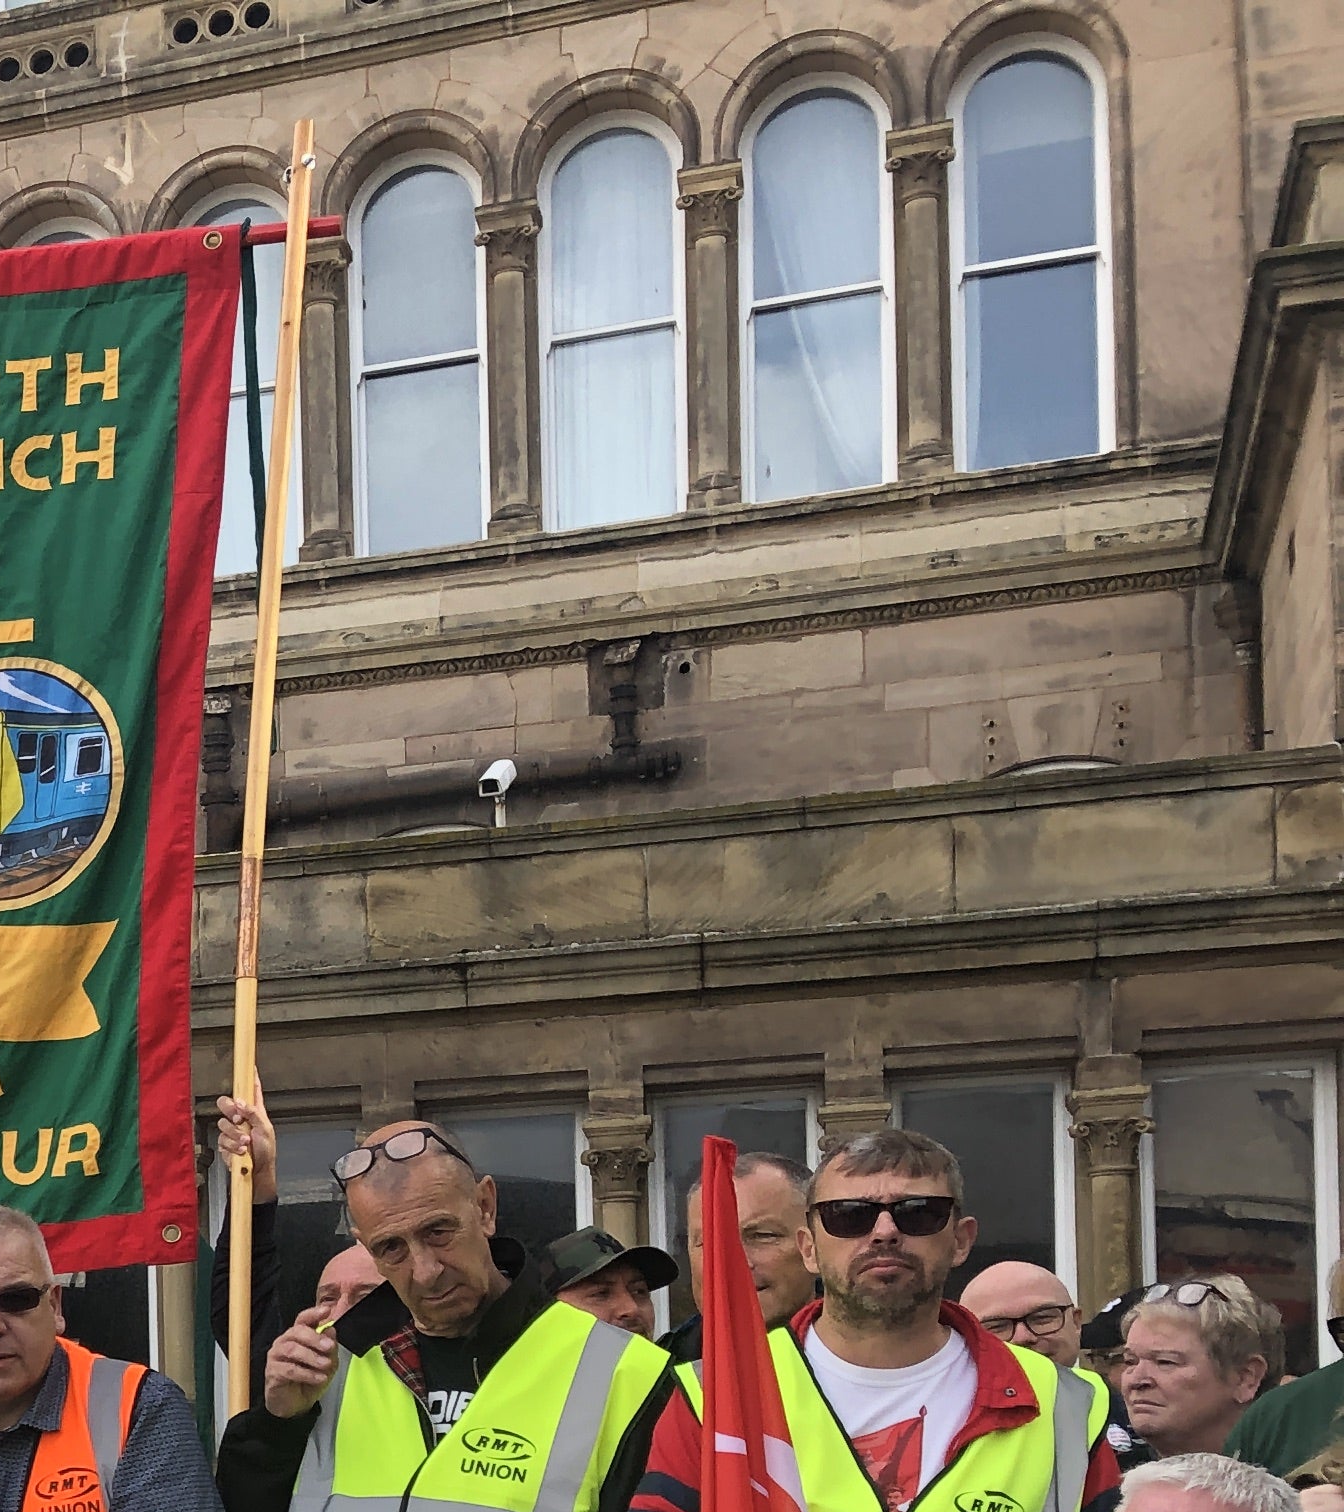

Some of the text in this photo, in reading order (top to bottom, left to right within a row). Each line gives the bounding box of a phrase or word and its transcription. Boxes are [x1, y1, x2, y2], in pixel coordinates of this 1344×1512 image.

[476, 1435, 524, 1454] RMT
[461, 1458, 527, 1483] UNION
[48, 1476, 87, 1493] RMT
